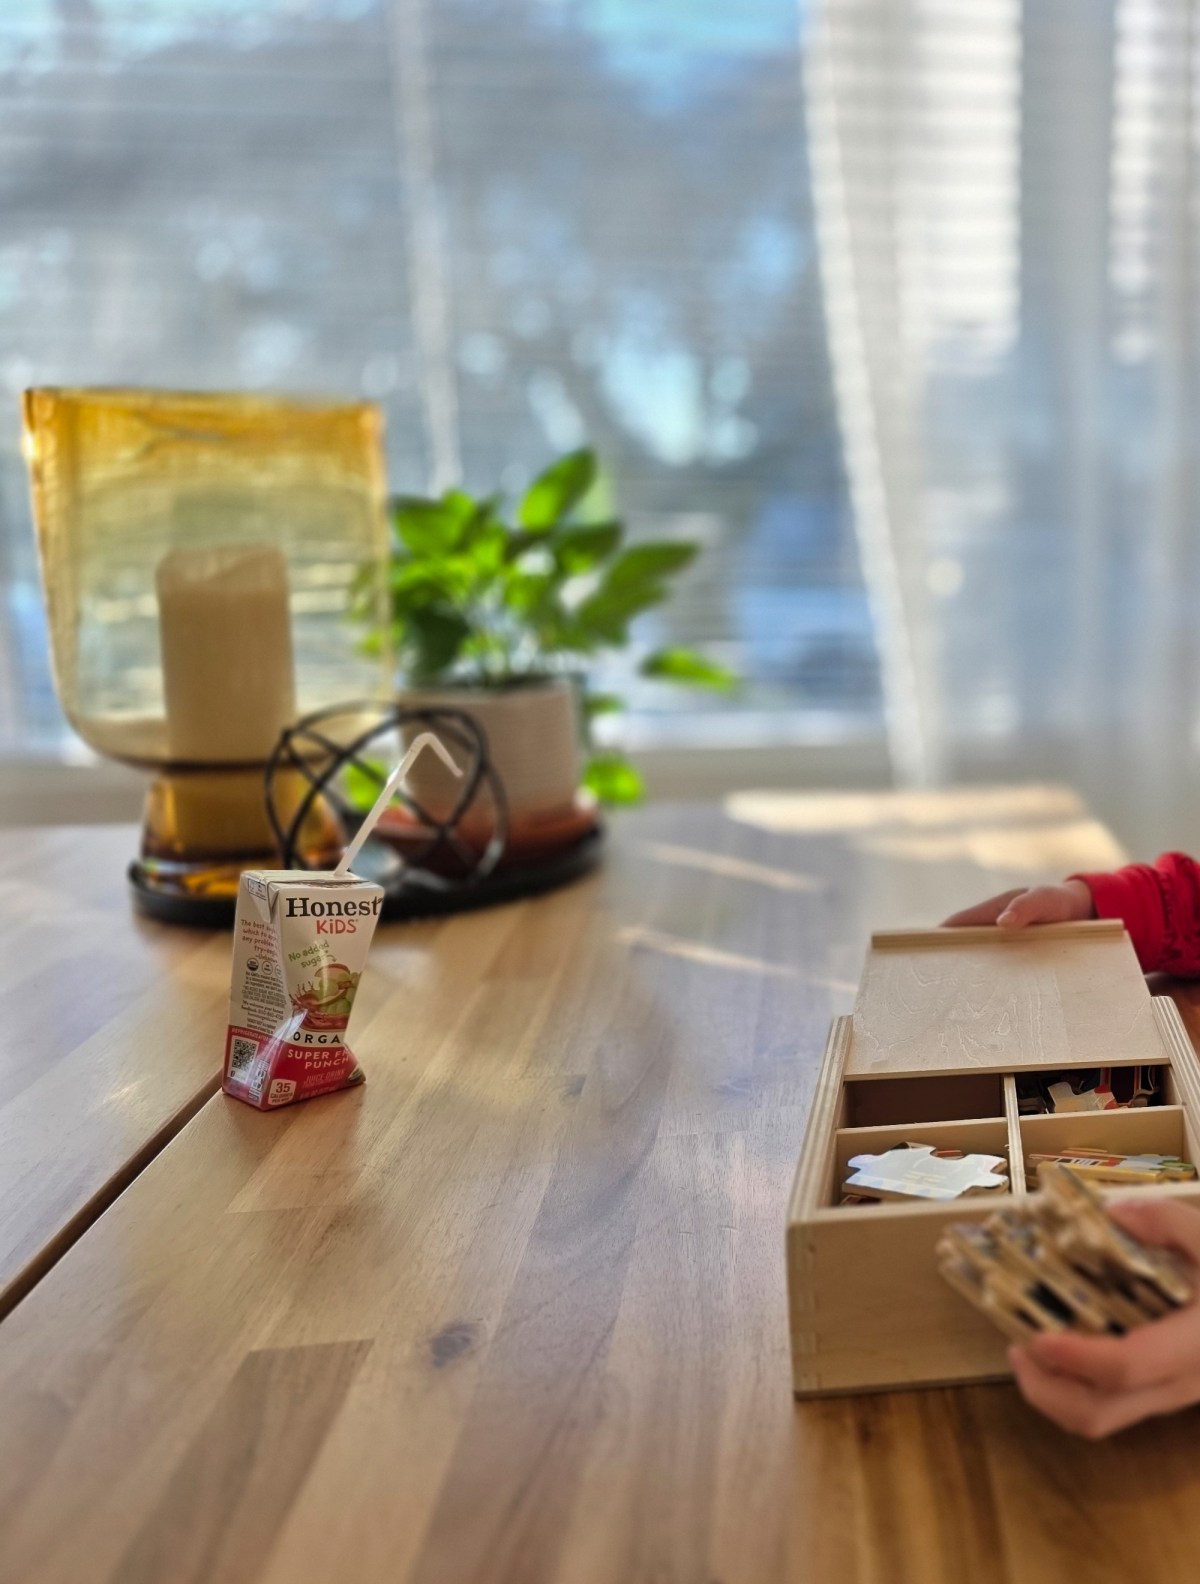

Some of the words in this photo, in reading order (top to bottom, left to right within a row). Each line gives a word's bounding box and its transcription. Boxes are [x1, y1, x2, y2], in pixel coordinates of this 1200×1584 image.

[285, 896, 382, 918] Honest
[288, 951, 302, 962] No
[302, 940, 330, 958] added
[293, 1031, 341, 1044] ORGA
[287, 1049, 330, 1060] SUPER
[275, 1082, 291, 1094] 35
